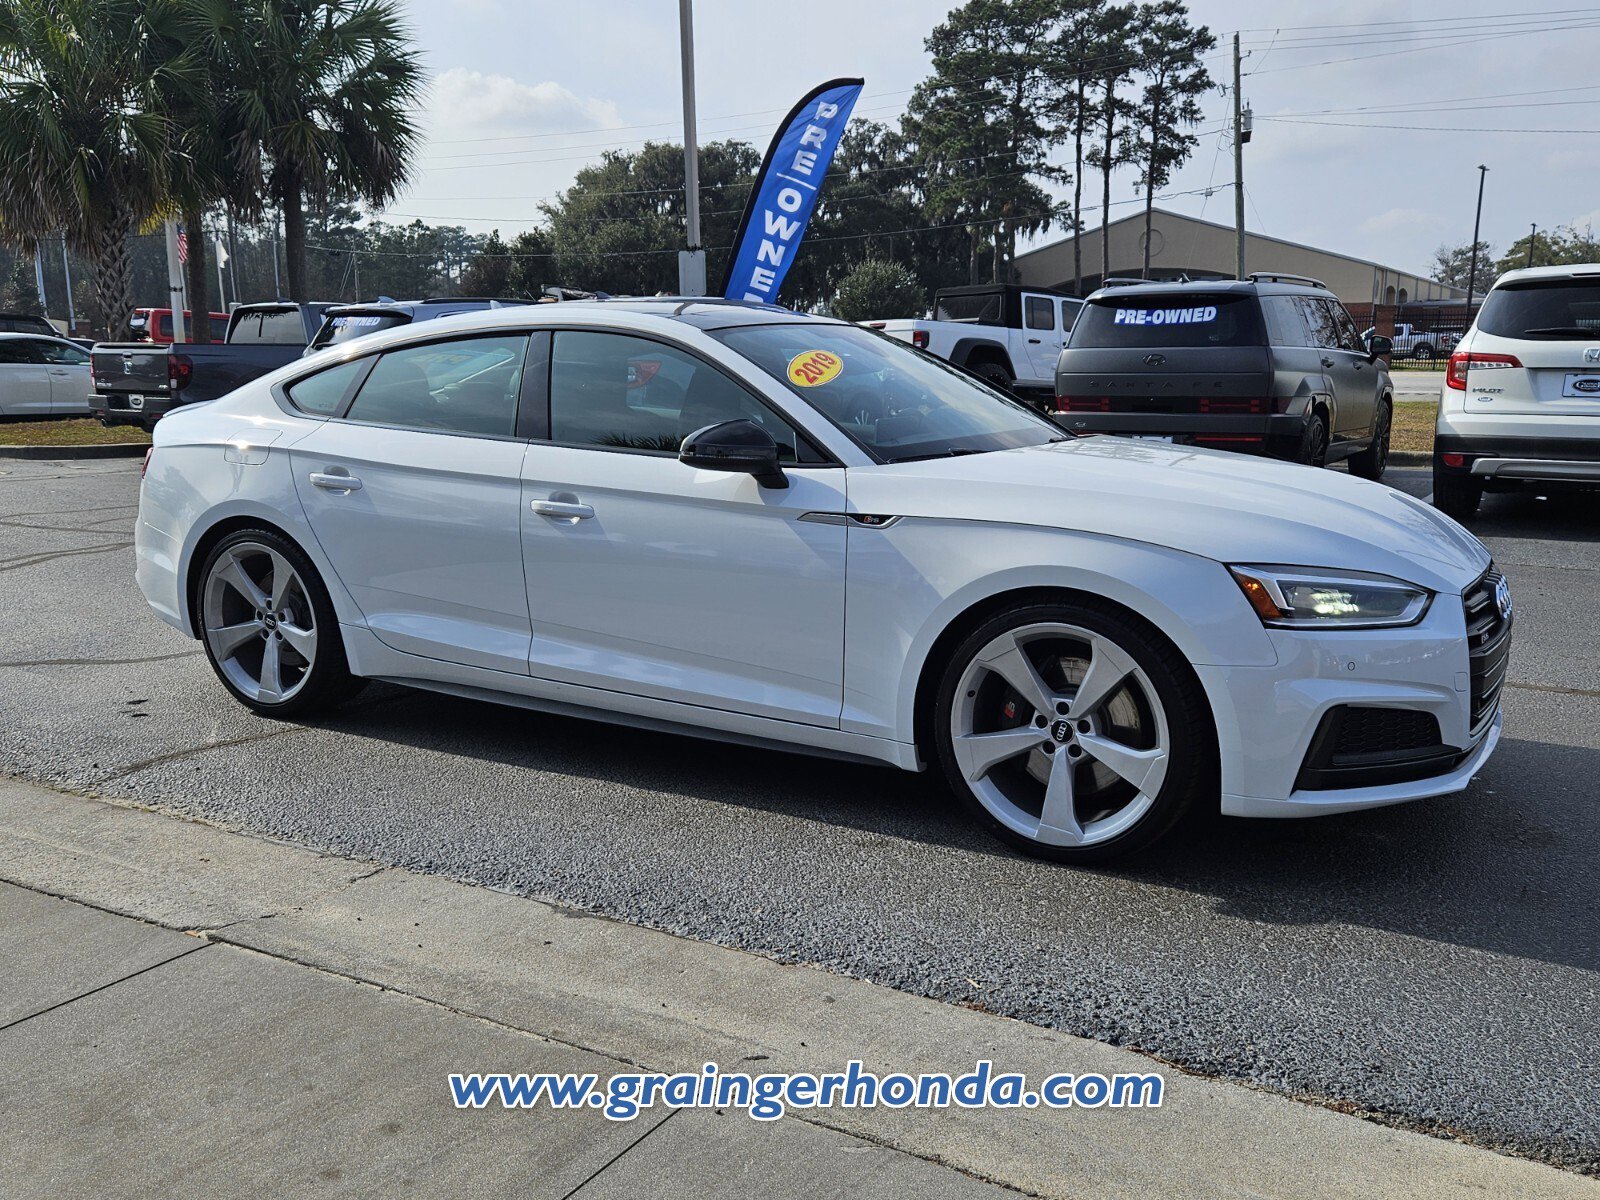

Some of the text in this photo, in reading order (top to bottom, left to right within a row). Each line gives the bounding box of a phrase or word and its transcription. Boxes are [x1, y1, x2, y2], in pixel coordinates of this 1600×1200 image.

[1114, 306, 1217, 324] PRE-OWNED
[794, 352, 836, 384] 2019
[1089, 380, 1225, 389] SANTA FE
